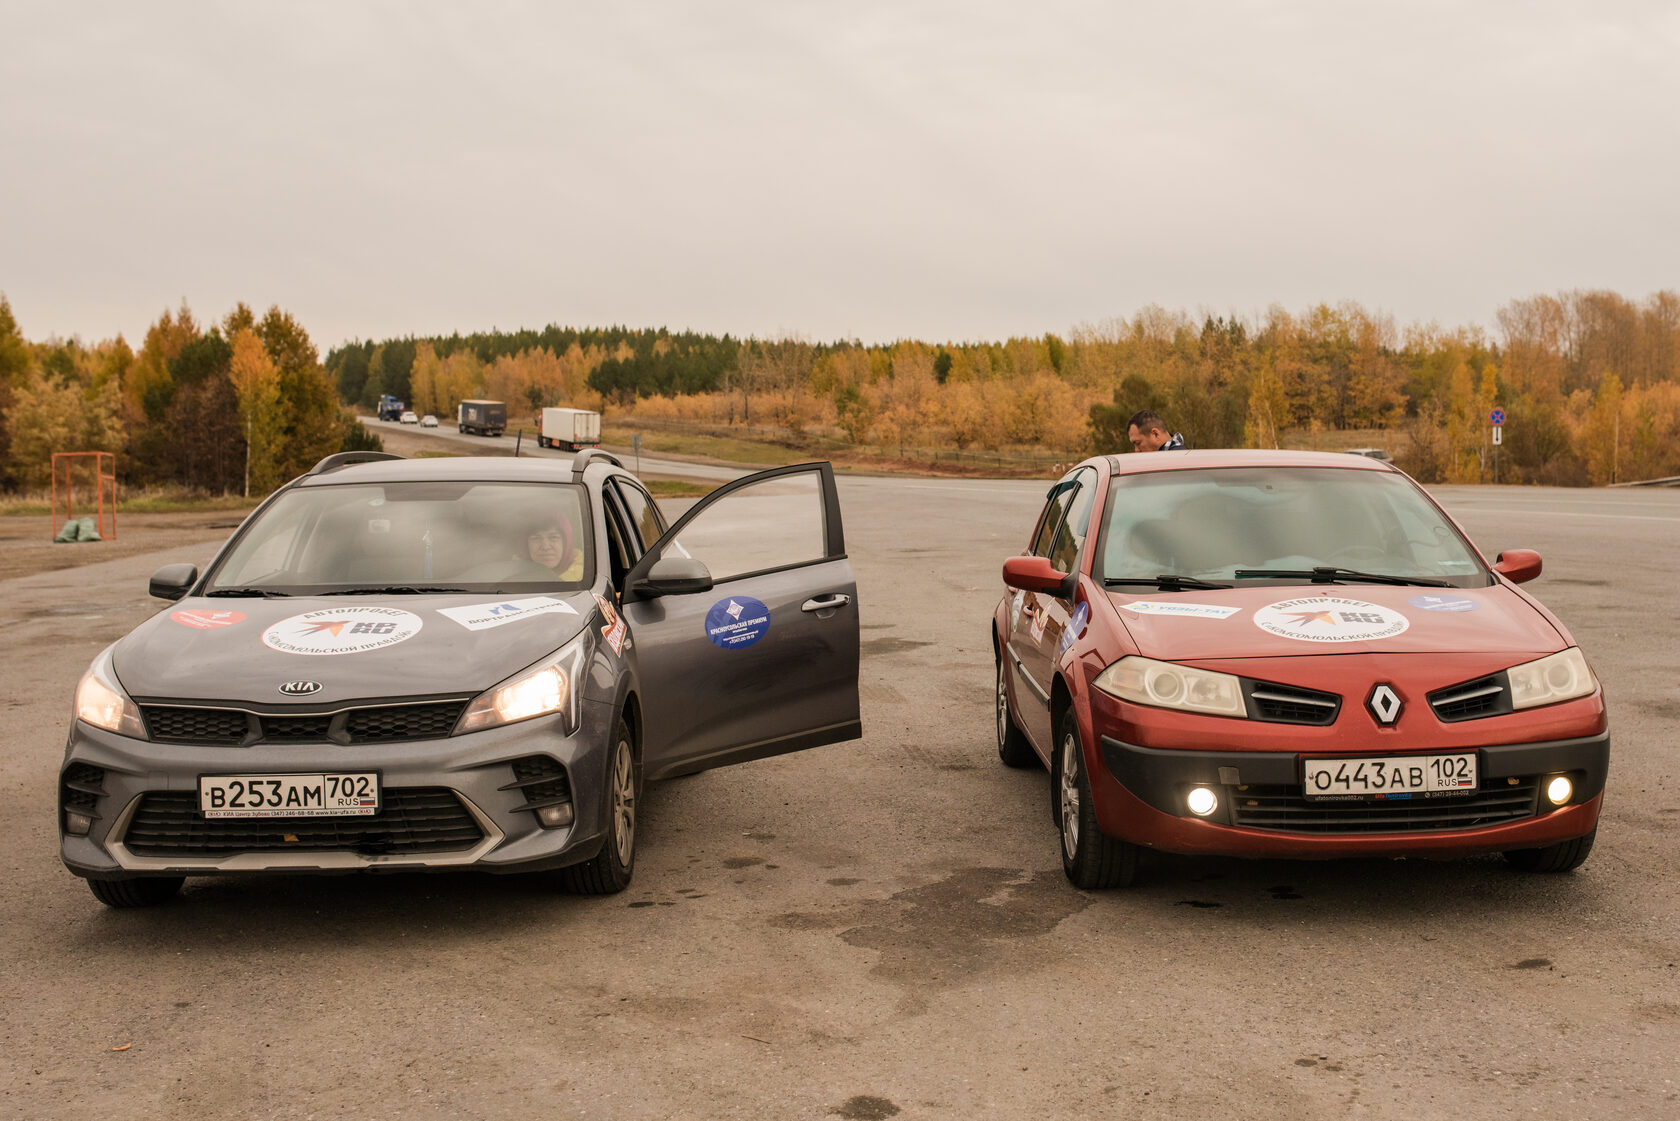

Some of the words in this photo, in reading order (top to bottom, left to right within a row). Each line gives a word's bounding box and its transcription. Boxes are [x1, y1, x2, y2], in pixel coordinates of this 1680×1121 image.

[1271, 598, 1374, 611] АВТОПРОБЕГ
[304, 607, 408, 619] АВТОПРОБЕГ
[285, 682, 314, 691] KIA
[1430, 757, 1469, 779] 102
[326, 776, 370, 798] 702
[1437, 778, 1458, 787] RUS
[337, 797, 360, 806] RUS
